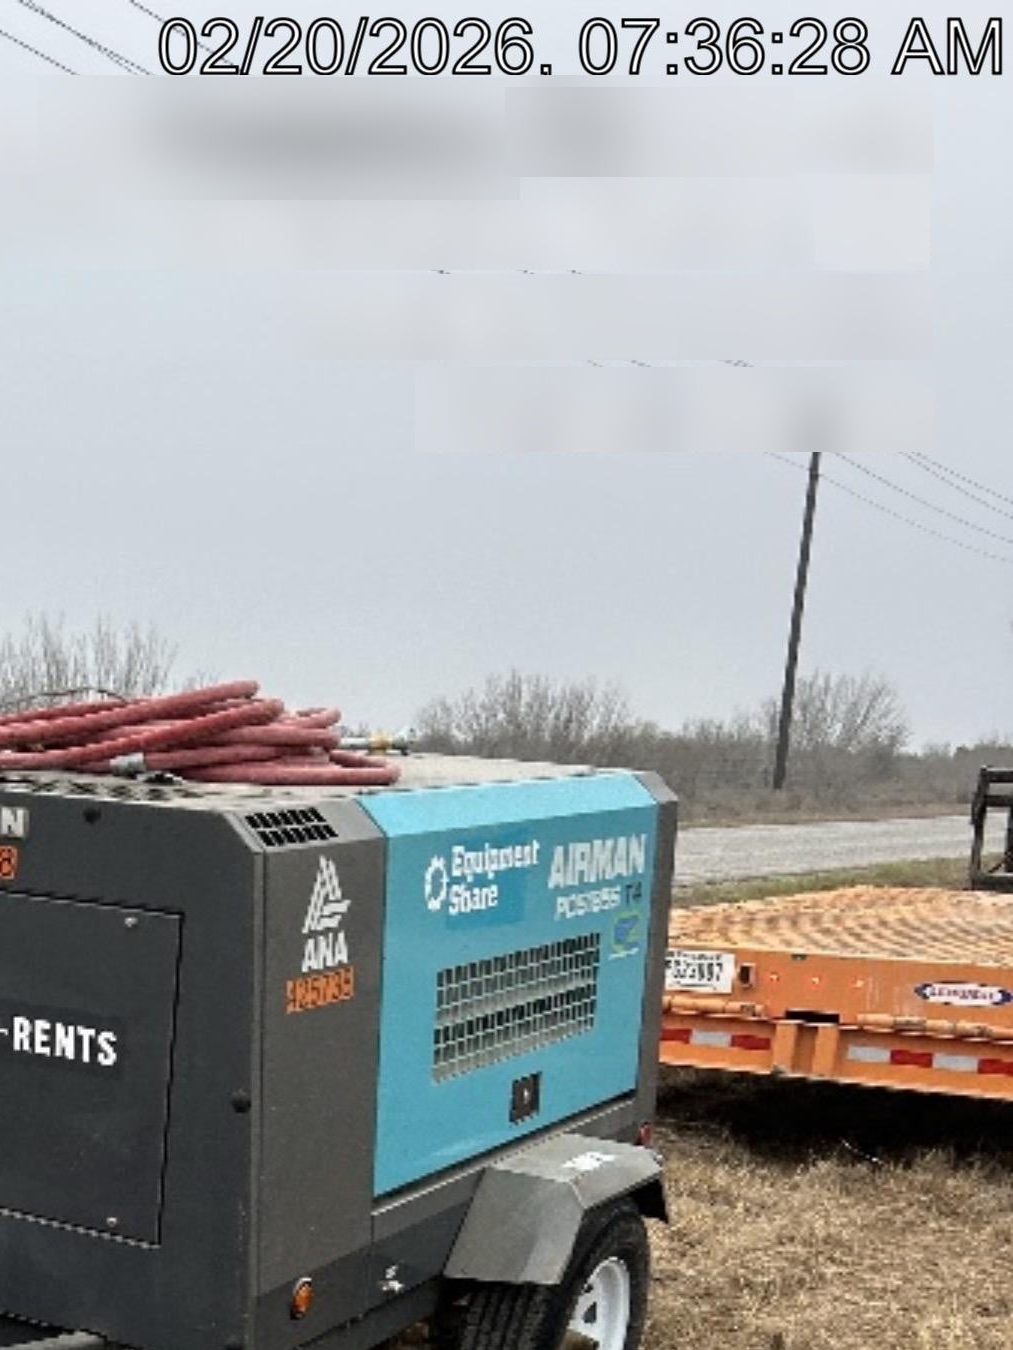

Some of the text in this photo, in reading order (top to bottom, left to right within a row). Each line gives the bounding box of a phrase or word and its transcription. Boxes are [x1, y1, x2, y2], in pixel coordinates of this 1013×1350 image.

[451, 840, 540, 882] Equipment
[548, 834, 646, 889] AIRMAN
[449, 884, 498, 915] Share
[301, 931, 348, 972] ANA
